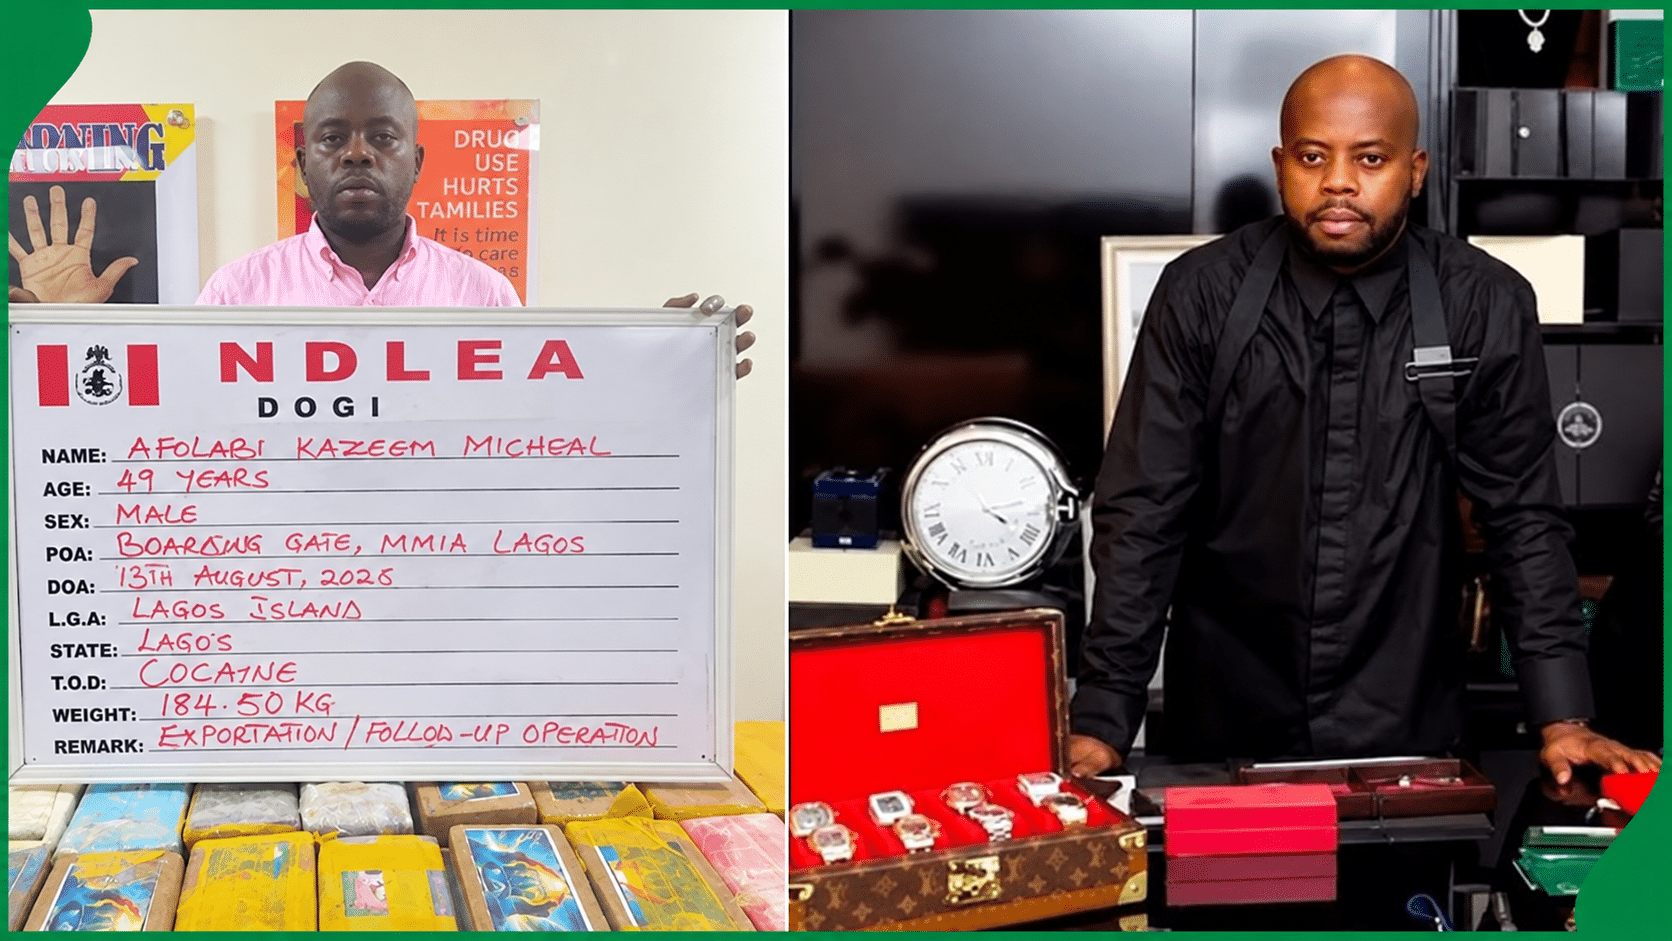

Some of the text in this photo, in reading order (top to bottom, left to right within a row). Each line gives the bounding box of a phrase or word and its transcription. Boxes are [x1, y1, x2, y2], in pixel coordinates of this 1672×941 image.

[475, 153, 519, 172] USE
[443, 177, 519, 196] HURTS
[434, 226, 519, 243] It is time
[478, 249, 519, 261] care
[220, 340, 584, 383] NDLEA
[259, 397, 378, 417] DOGI
[42, 435, 611, 463] NAME: AFOLABI KAZEEM MICHEAL
[44, 468, 269, 496] AGE: 49 YEARS
[45, 504, 197, 528] SEX: MALE
[47, 547, 92, 561] POA:
[285, 533, 361, 555] GATE,
[381, 533, 466, 553] MMIA
[494, 530, 584, 554] LAGOS
[48, 580, 94, 594] DOA:
[194, 565, 306, 587] AUGUST,
[50, 596, 361, 626] L.G.A: LAGOS ISLAND
[51, 628, 232, 658] STATE: LAGOS
[51, 676, 105, 690] T.O.D:
[53, 691, 331, 722] WEIGHT: 184.50 KG
[55, 740, 143, 753] REMARK:
[158, 722, 337, 747] EXPORTATION
[523, 722, 658, 748] OPERATION
